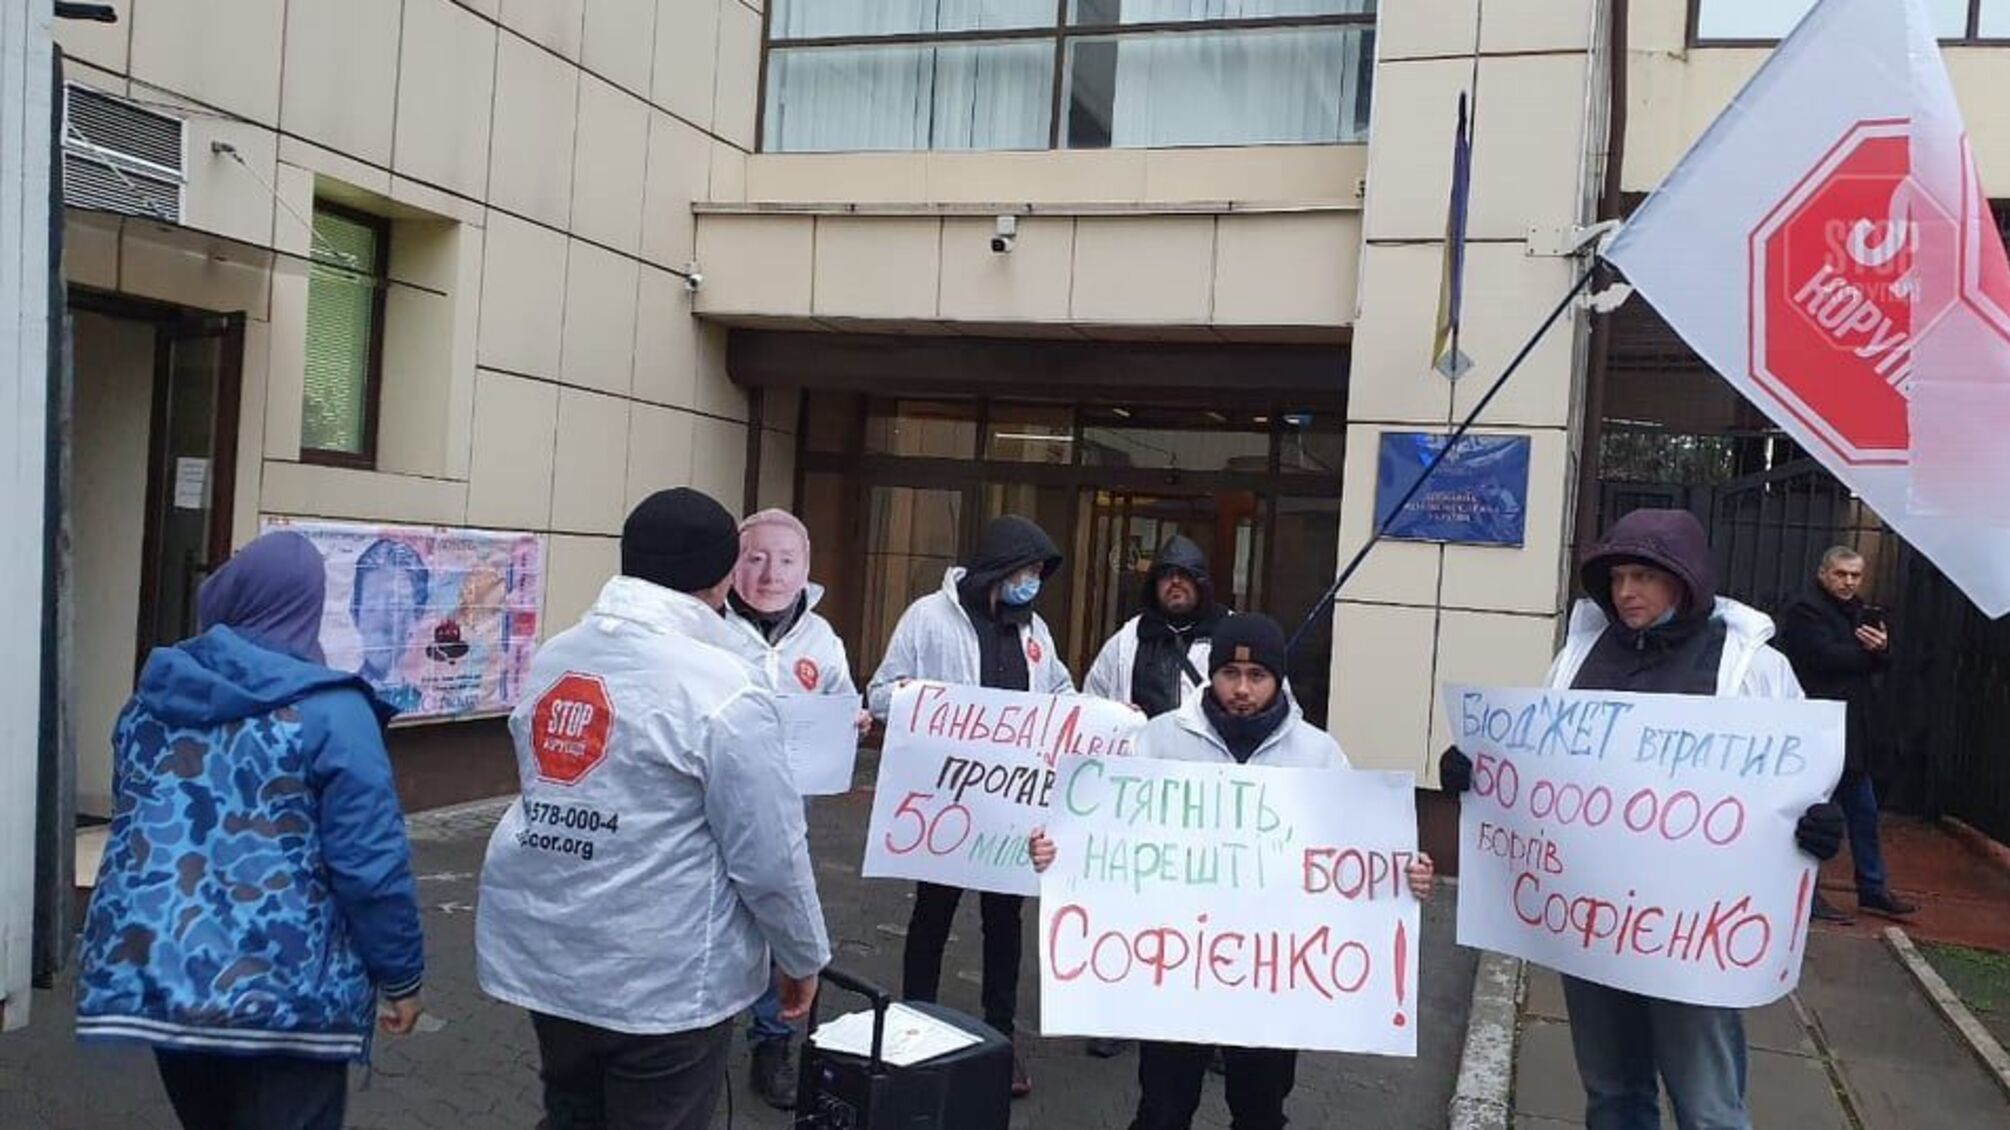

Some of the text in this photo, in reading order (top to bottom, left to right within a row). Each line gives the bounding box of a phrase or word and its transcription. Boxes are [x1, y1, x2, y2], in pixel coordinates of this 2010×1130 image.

[547, 699, 594, 738] STOP
[1462, 692, 1635, 760] БЮДЖЕТ
[884, 791, 971, 856] 50
[1472, 752, 1746, 846] 50 000 000
